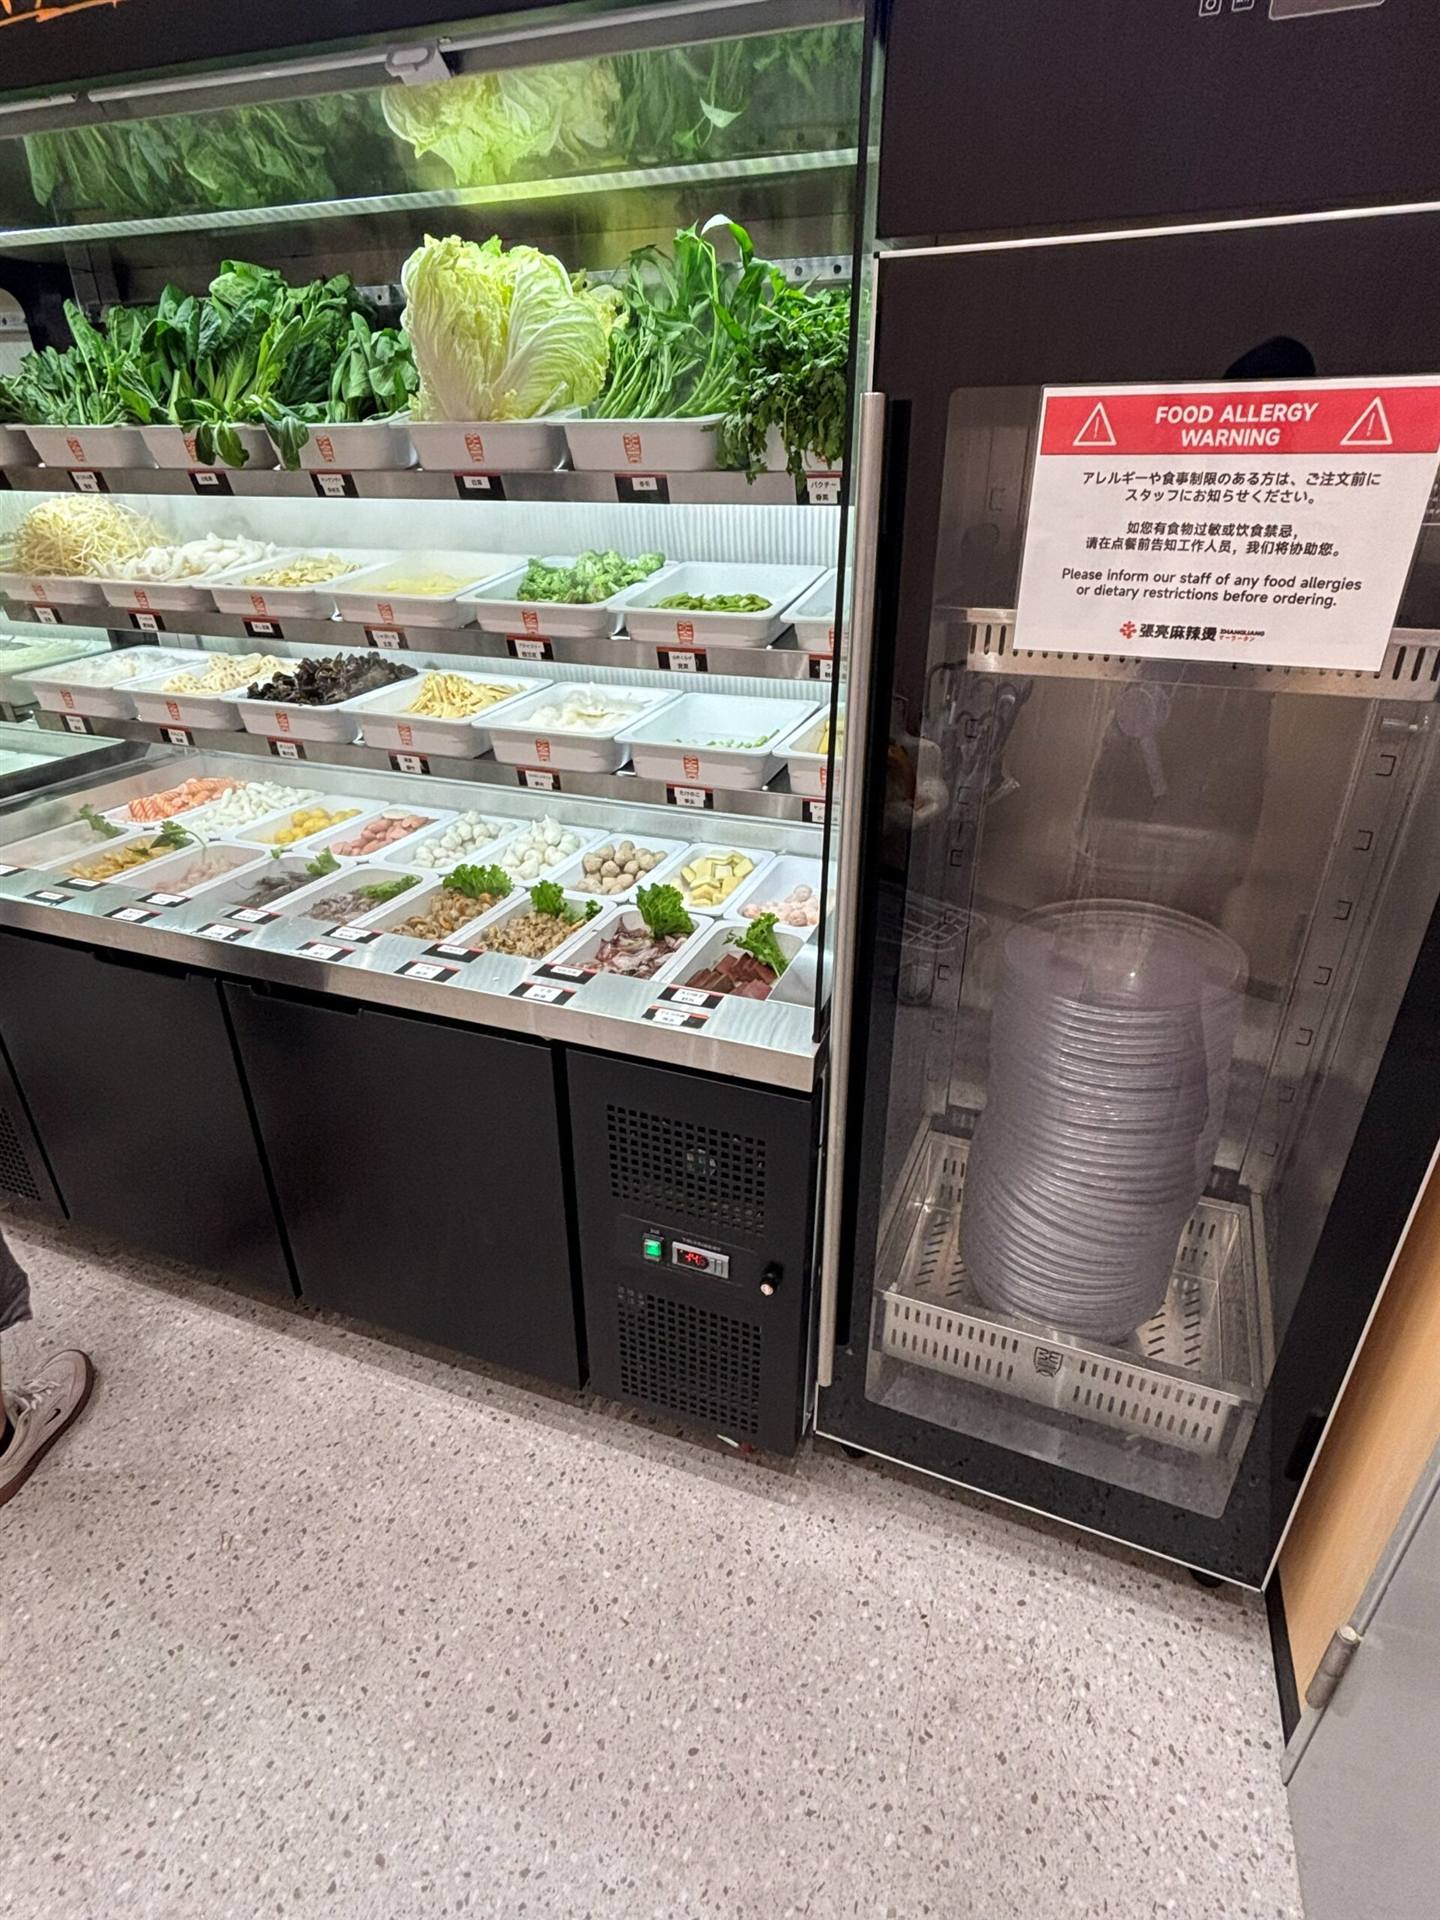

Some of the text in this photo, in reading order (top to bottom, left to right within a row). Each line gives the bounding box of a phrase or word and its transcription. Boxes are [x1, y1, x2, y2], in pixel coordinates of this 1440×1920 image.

[1156, 402, 1319, 424] FOOD ALLERGY
[1181, 428, 1280, 447] WARNING
[1083, 471, 1381, 487] アレルギーや食事制限のある方は、ご注文前に
[1125, 488, 1316, 504] スタッフにお知らせください。
[1127, 521, 1298, 539] 如您有食物过敏或饮食禁忌，
[1086, 536, 1340, 558] 请在点餐前告知工作人员，我们将协助您。
[1062, 568, 1362, 591] Please inform our staff of any food allergies
[1076, 584, 1337, 608] or dietary restrictions before ordering.
